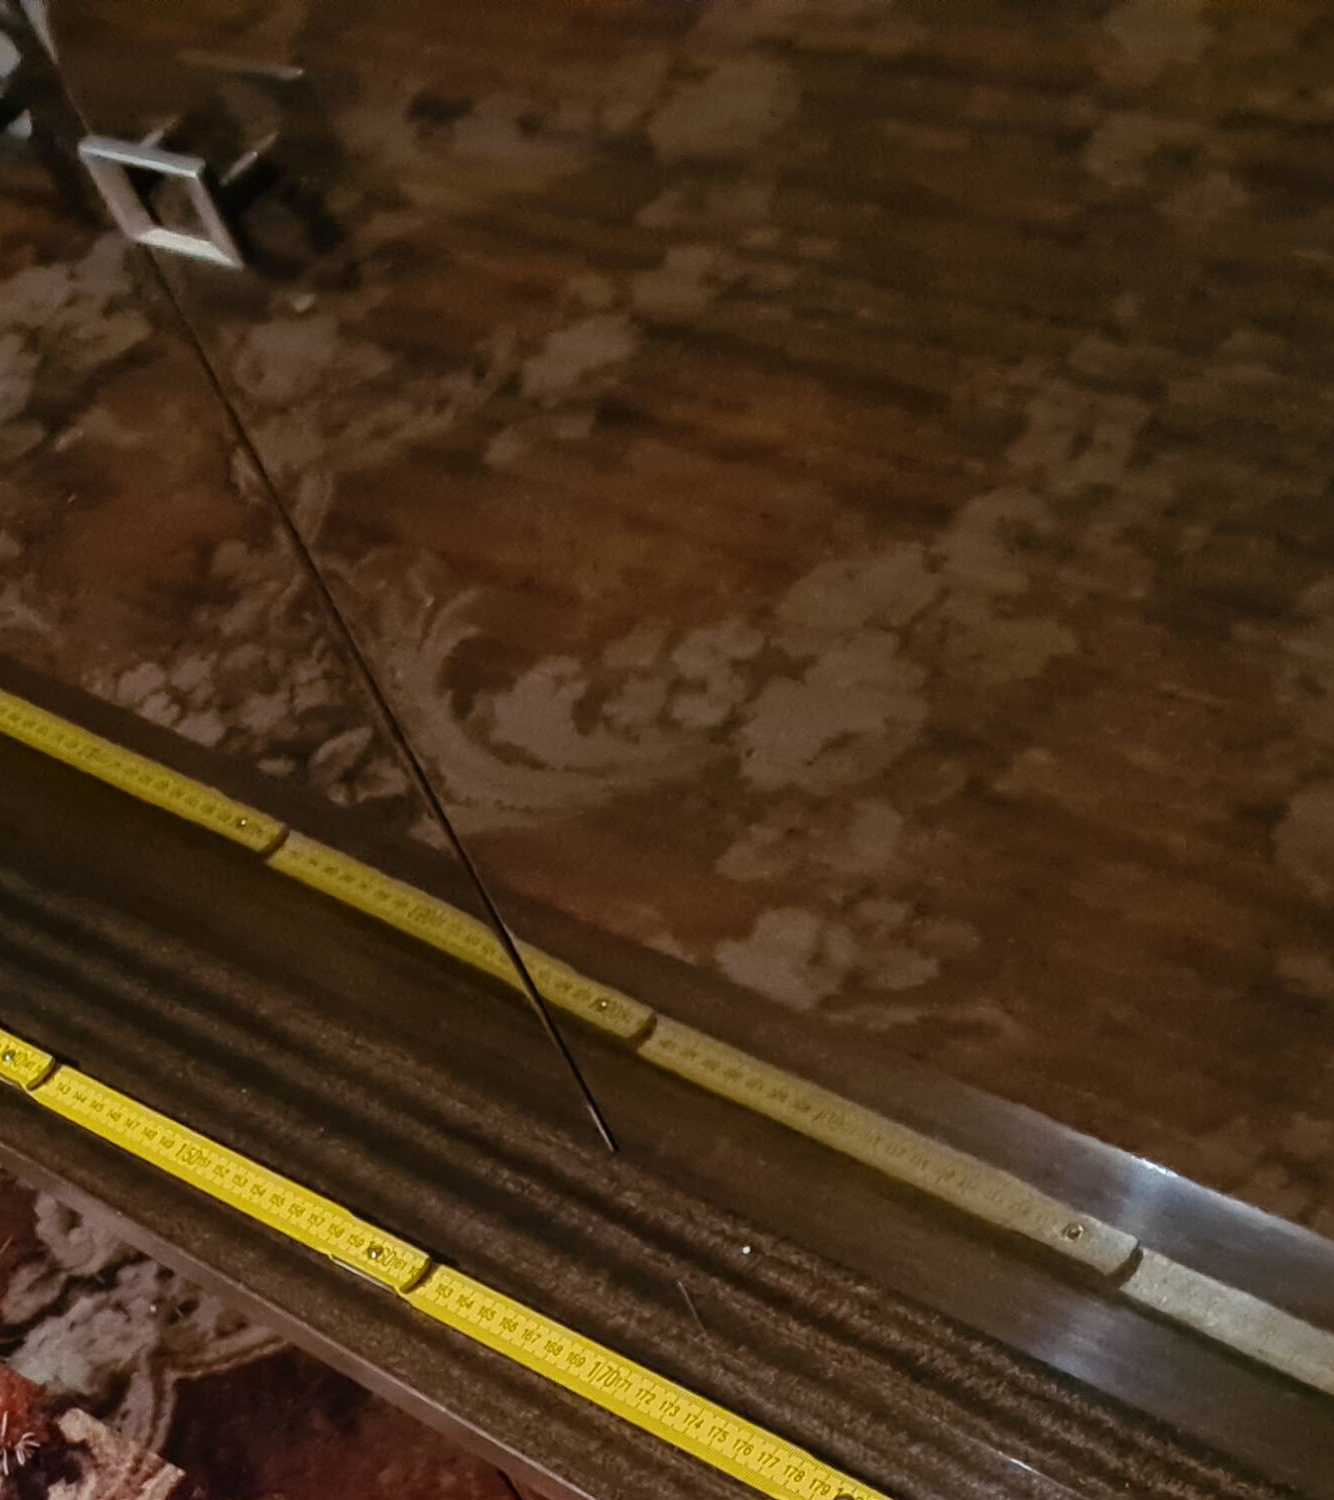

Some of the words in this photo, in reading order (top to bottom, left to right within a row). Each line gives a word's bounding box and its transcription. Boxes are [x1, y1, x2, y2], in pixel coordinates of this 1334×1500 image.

[588, 1361, 621, 1389] 170
[635, 1388, 656, 1405] 172
[659, 1400, 681, 1417] 173
[683, 1412, 705, 1430] 174
[707, 1425, 729, 1442] 175
[732, 1438, 755, 1456] 176
[757, 1451, 781, 1469] 177
[783, 1464, 806, 1482] 178
[809, 1479, 832, 1495] 179
